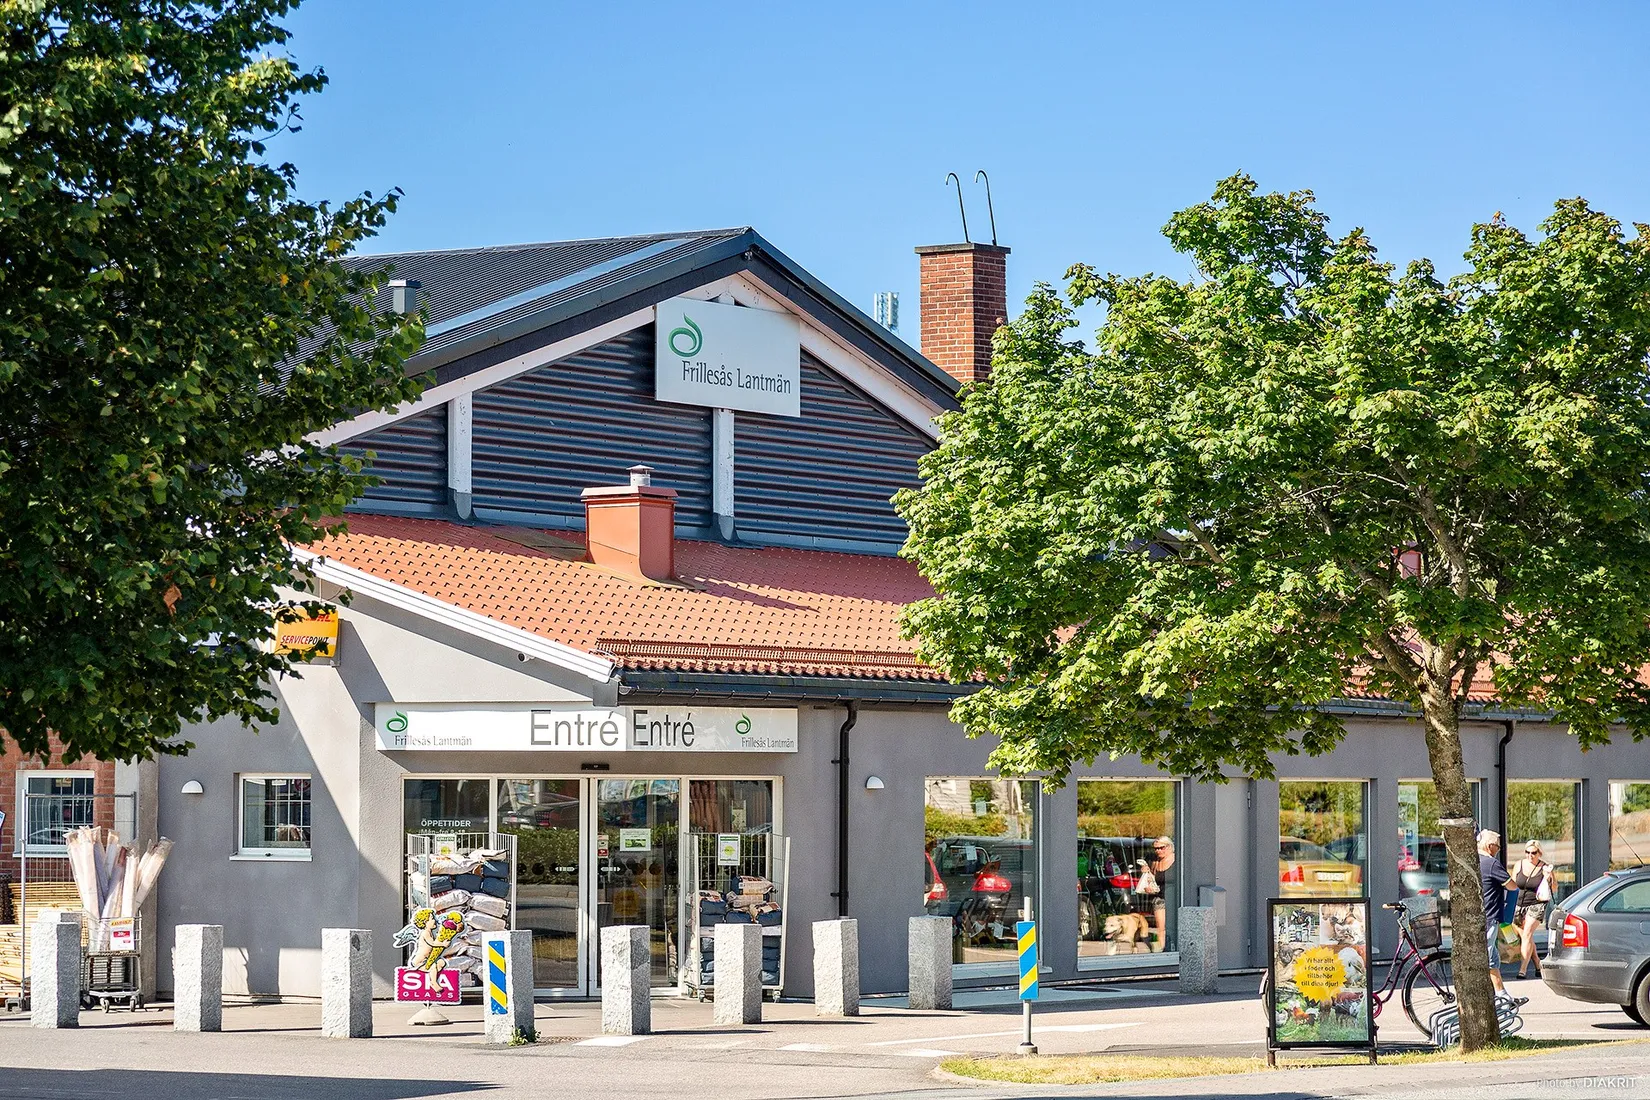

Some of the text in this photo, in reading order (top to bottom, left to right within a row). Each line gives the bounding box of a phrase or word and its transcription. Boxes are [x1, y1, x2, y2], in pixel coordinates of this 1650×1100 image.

[682, 360, 791, 394] Frillesås Lantmän
[531, 709, 619, 747] Entré
[633, 709, 695, 747] Entré
[395, 735, 472, 746] Frillesås Lantmän
[741, 737, 794, 748] Frillesås Lantmän
[421, 818, 471, 827] ÖPPETTIDER
